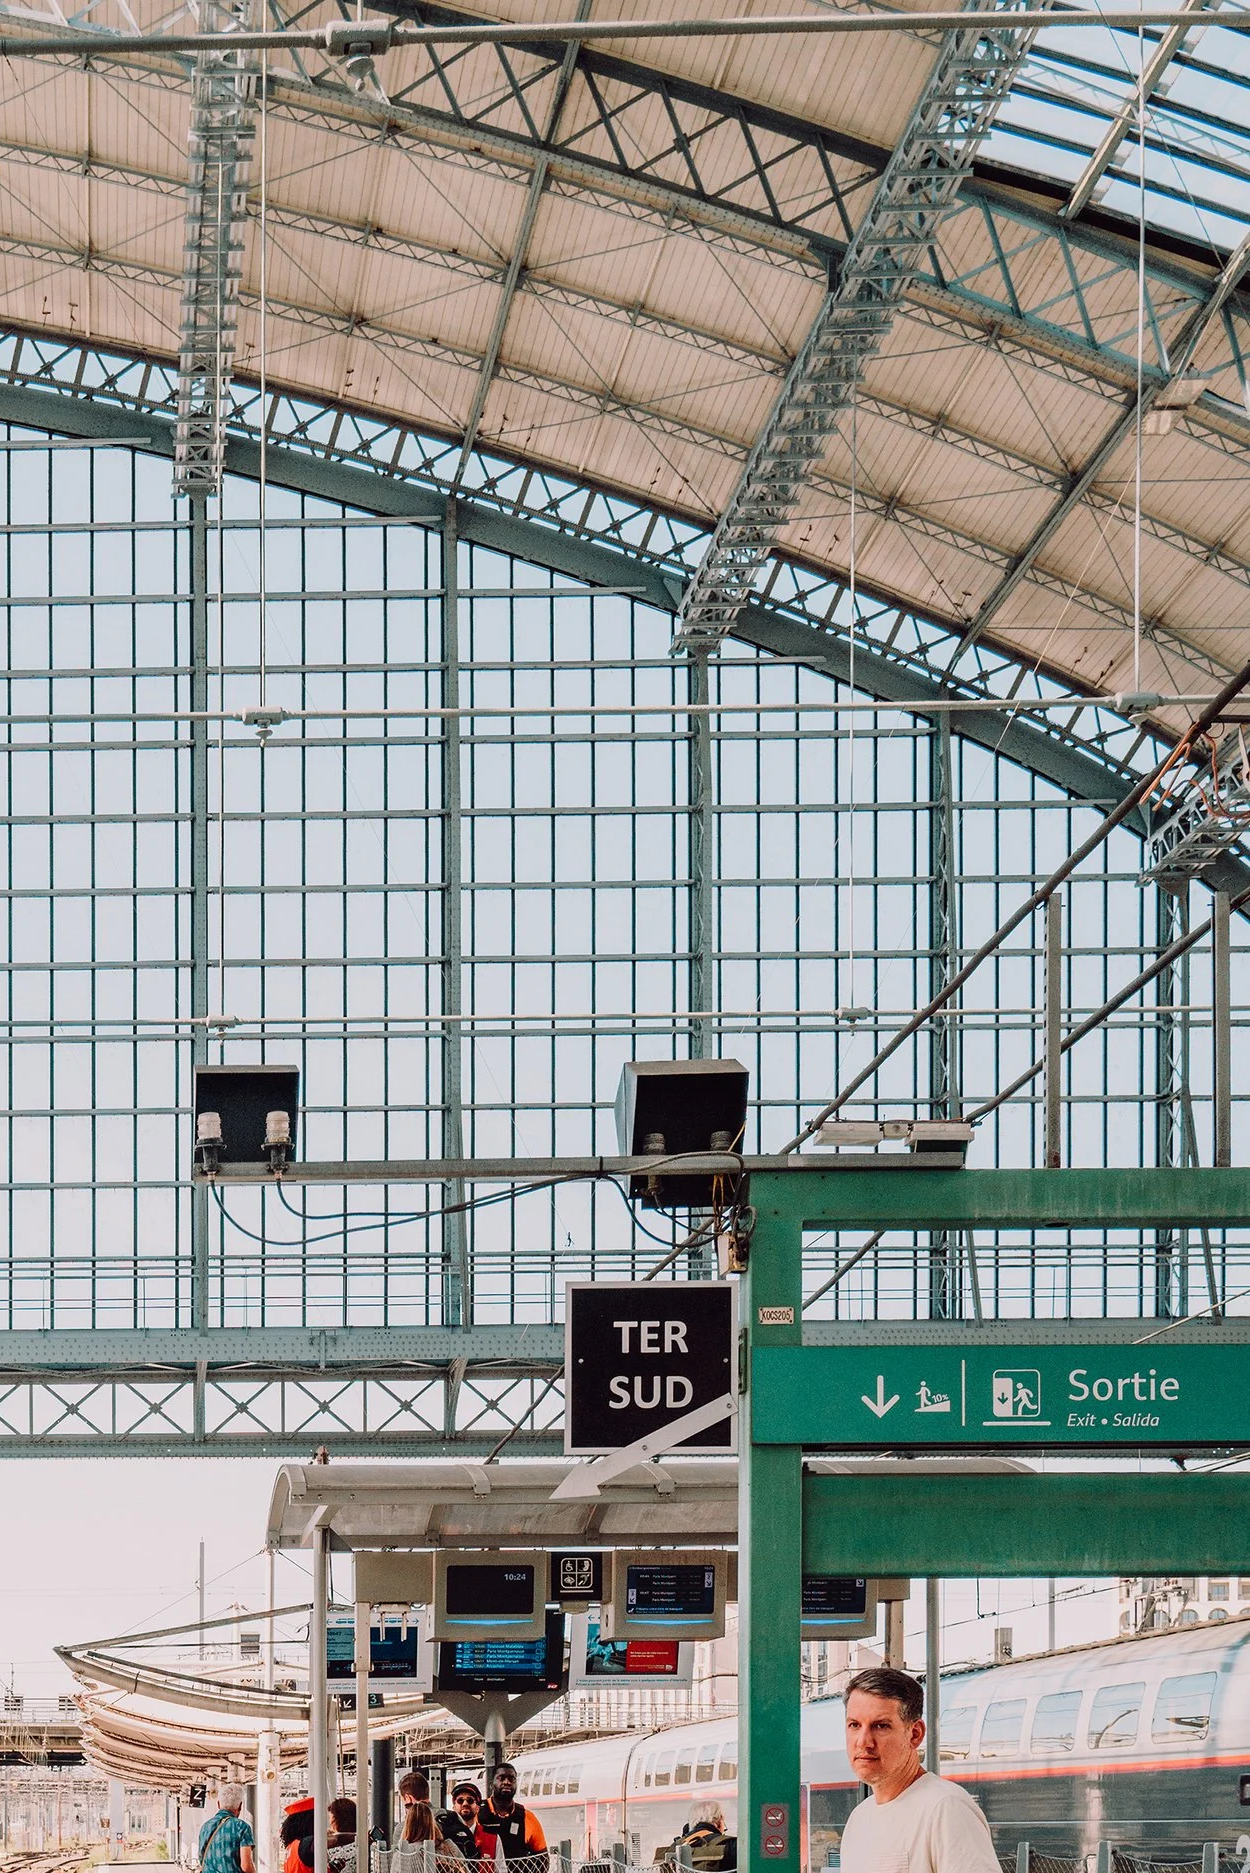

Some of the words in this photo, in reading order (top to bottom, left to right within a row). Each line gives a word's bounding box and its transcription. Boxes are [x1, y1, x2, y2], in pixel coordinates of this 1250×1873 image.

[613, 1320, 689, 1354] TER
[1068, 1368, 1180, 1401] Sortie
[608, 1375, 694, 1410] SUD
[931, 1393, 949, 1404] 10%
[1067, 1413, 1097, 1427] Exit
[1112, 1412, 1160, 1427] Salida
[503, 1573, 527, 1581] 10:24
[370, 1694, 377, 1704] 3
[193, 1788, 204, 1800] Z
